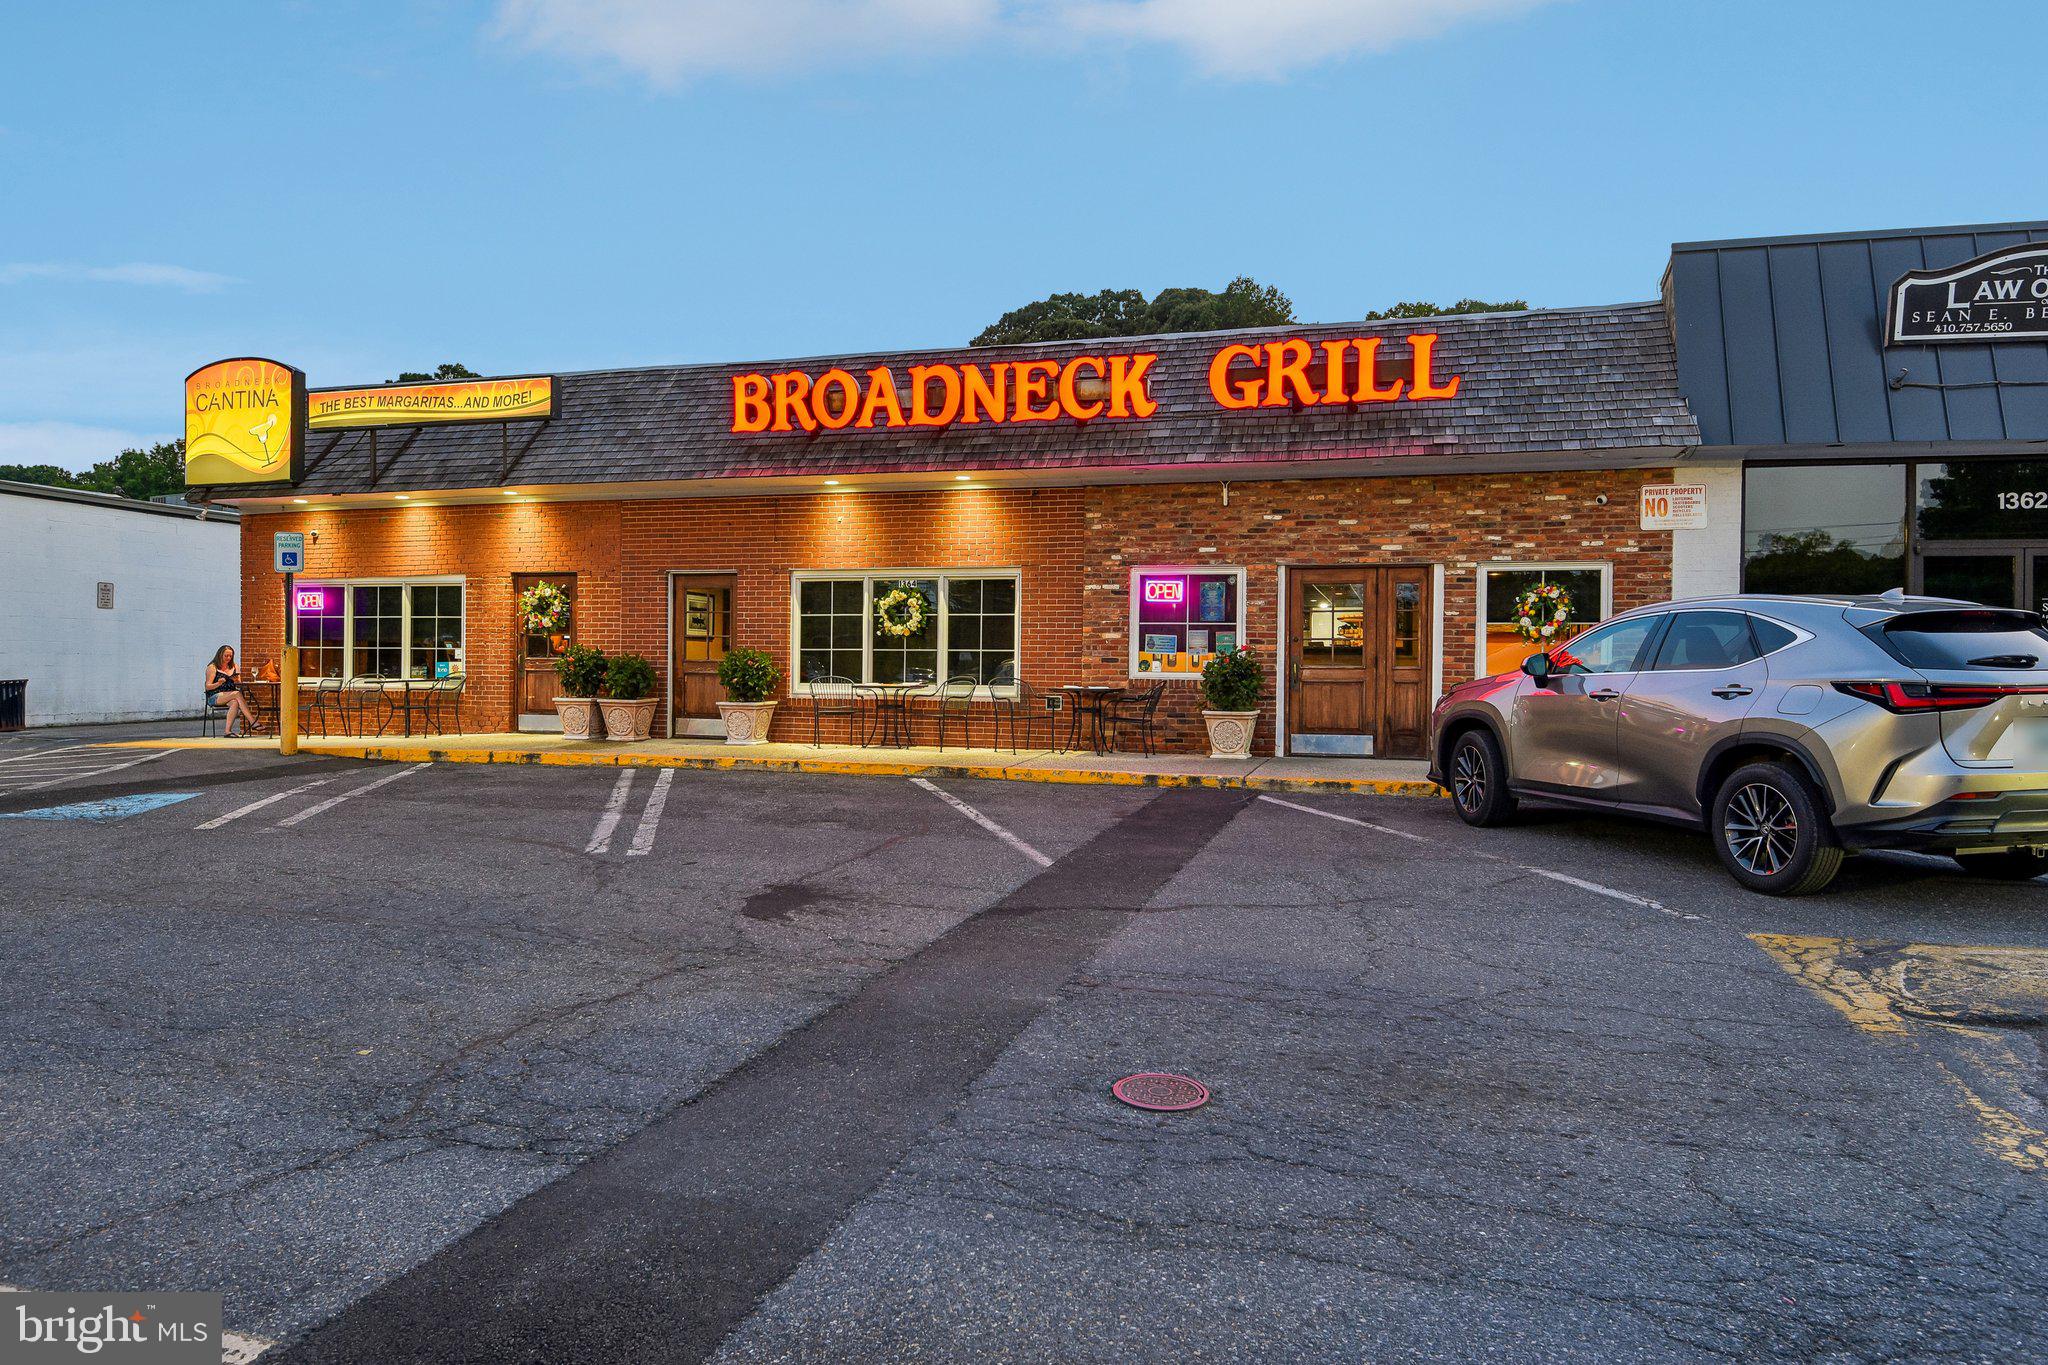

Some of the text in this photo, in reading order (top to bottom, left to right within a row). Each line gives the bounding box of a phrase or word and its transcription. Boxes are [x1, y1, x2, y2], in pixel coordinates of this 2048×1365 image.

[1946, 279, 2024, 309] LAW
[1911, 309, 1972, 323] SEAN
[1989, 308, 2007, 320] E.
[1934, 322, 2013, 333] 410.757.5650
[196, 376, 282, 390] BROADNECK
[731, 333, 1461, 433] BROADNECK GRILL
[196, 388, 279, 412] CANTINA
[320, 399, 341, 414] THE
[344, 396, 374, 409] BEST
[492, 390, 533, 407] MORE!
[1644, 487, 1703, 496] PRIVATE PROPERTY
[1644, 497, 1668, 517] NO
[1997, 491, 2048, 510] 1362
[1147, 583, 1181, 599] OPEN
[300, 594, 322, 607] OPEN
